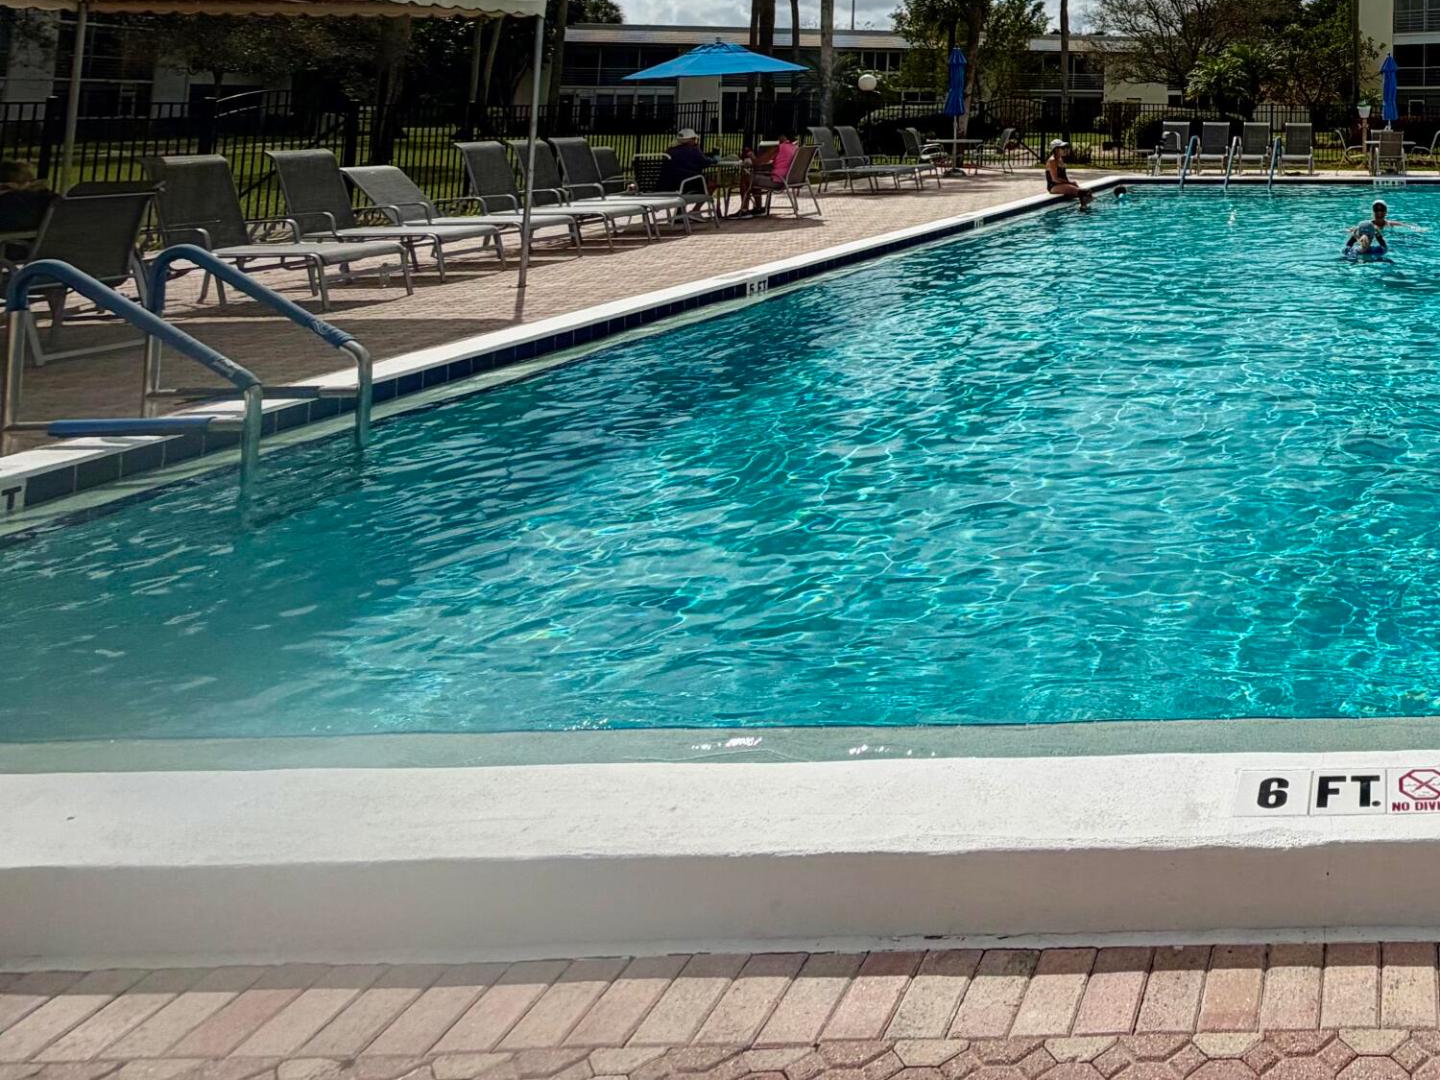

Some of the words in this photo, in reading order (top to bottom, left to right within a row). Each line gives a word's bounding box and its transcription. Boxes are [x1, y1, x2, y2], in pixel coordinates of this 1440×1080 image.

[1256, 777, 1290, 809] 6
[1316, 775, 1381, 808] FT.
[1391, 801, 1410, 812] NO
